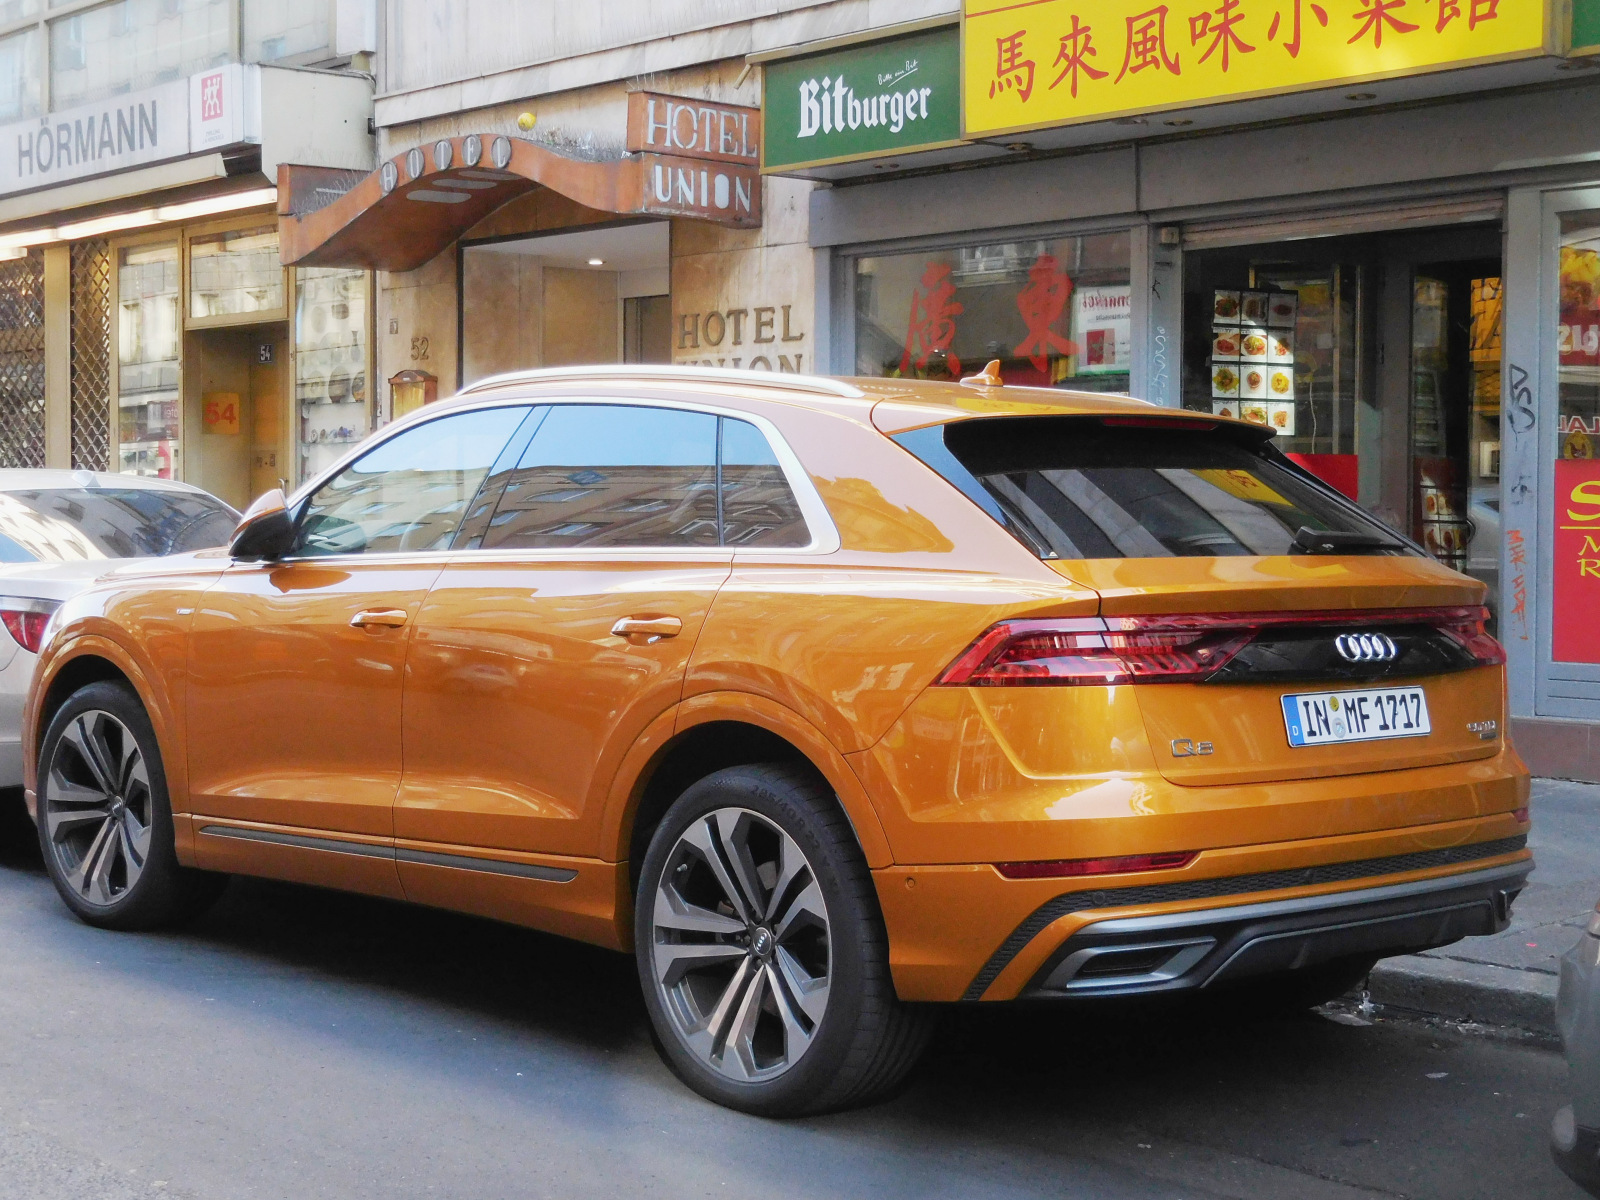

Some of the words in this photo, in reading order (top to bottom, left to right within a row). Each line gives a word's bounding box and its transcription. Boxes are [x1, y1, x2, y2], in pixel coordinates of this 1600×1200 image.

[647, 99, 758, 158] HOTEL
[797, 74, 932, 138] Bitburger
[17, 100, 158, 178] HÖRMANN
[382, 135, 507, 192] HOTEL
[654, 164, 752, 213] UNION
[410, 336, 430, 361] 52
[677, 304, 804, 350] HOTEL
[260, 346, 271, 361] 54
[205, 402, 236, 425] 54
[1292, 726, 1299, 736] D
[1302, 700, 1331, 737] IN
[1343, 697, 1370, 733] MF
[1374, 693, 1421, 730] 1717
[1170, 738, 1213, 757] Q8
